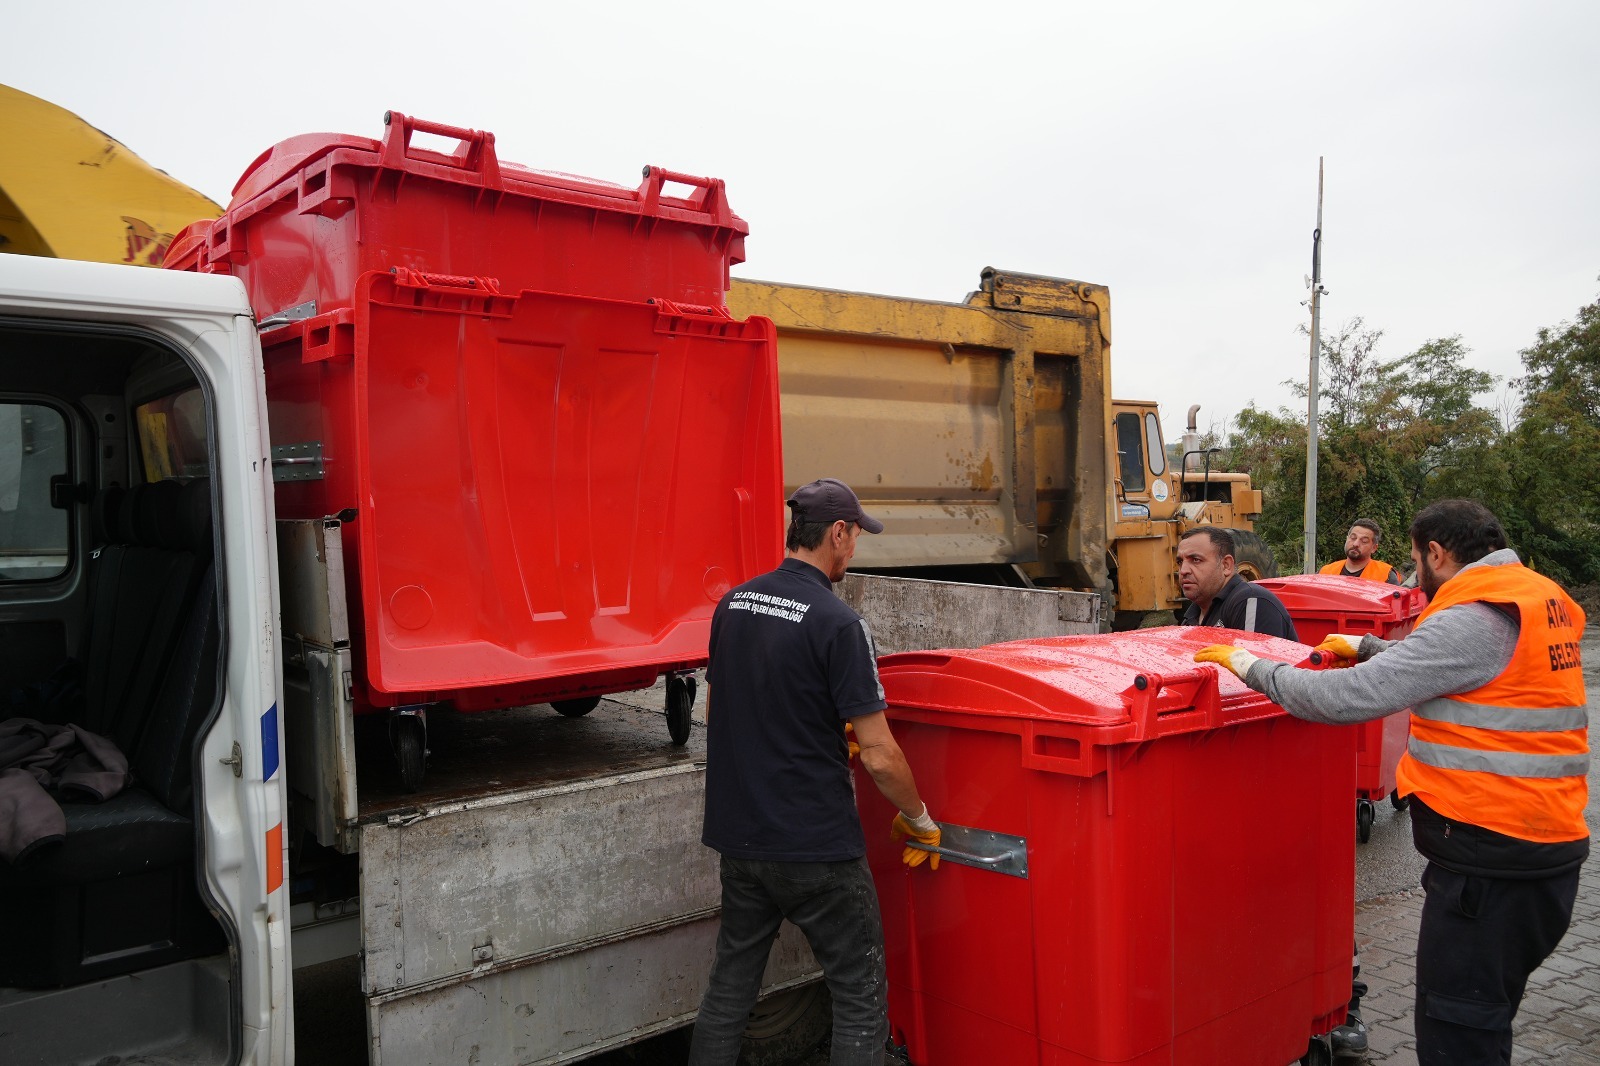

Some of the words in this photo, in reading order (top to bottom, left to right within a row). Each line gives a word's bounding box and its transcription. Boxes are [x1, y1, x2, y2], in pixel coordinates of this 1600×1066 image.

[728, 599, 752, 611] TEMİZLİK
[751, 601, 770, 615] İŞLERİ
[741, 592, 772, 604] ATAKUM
[770, 595, 811, 613] BELEDİYESİ
